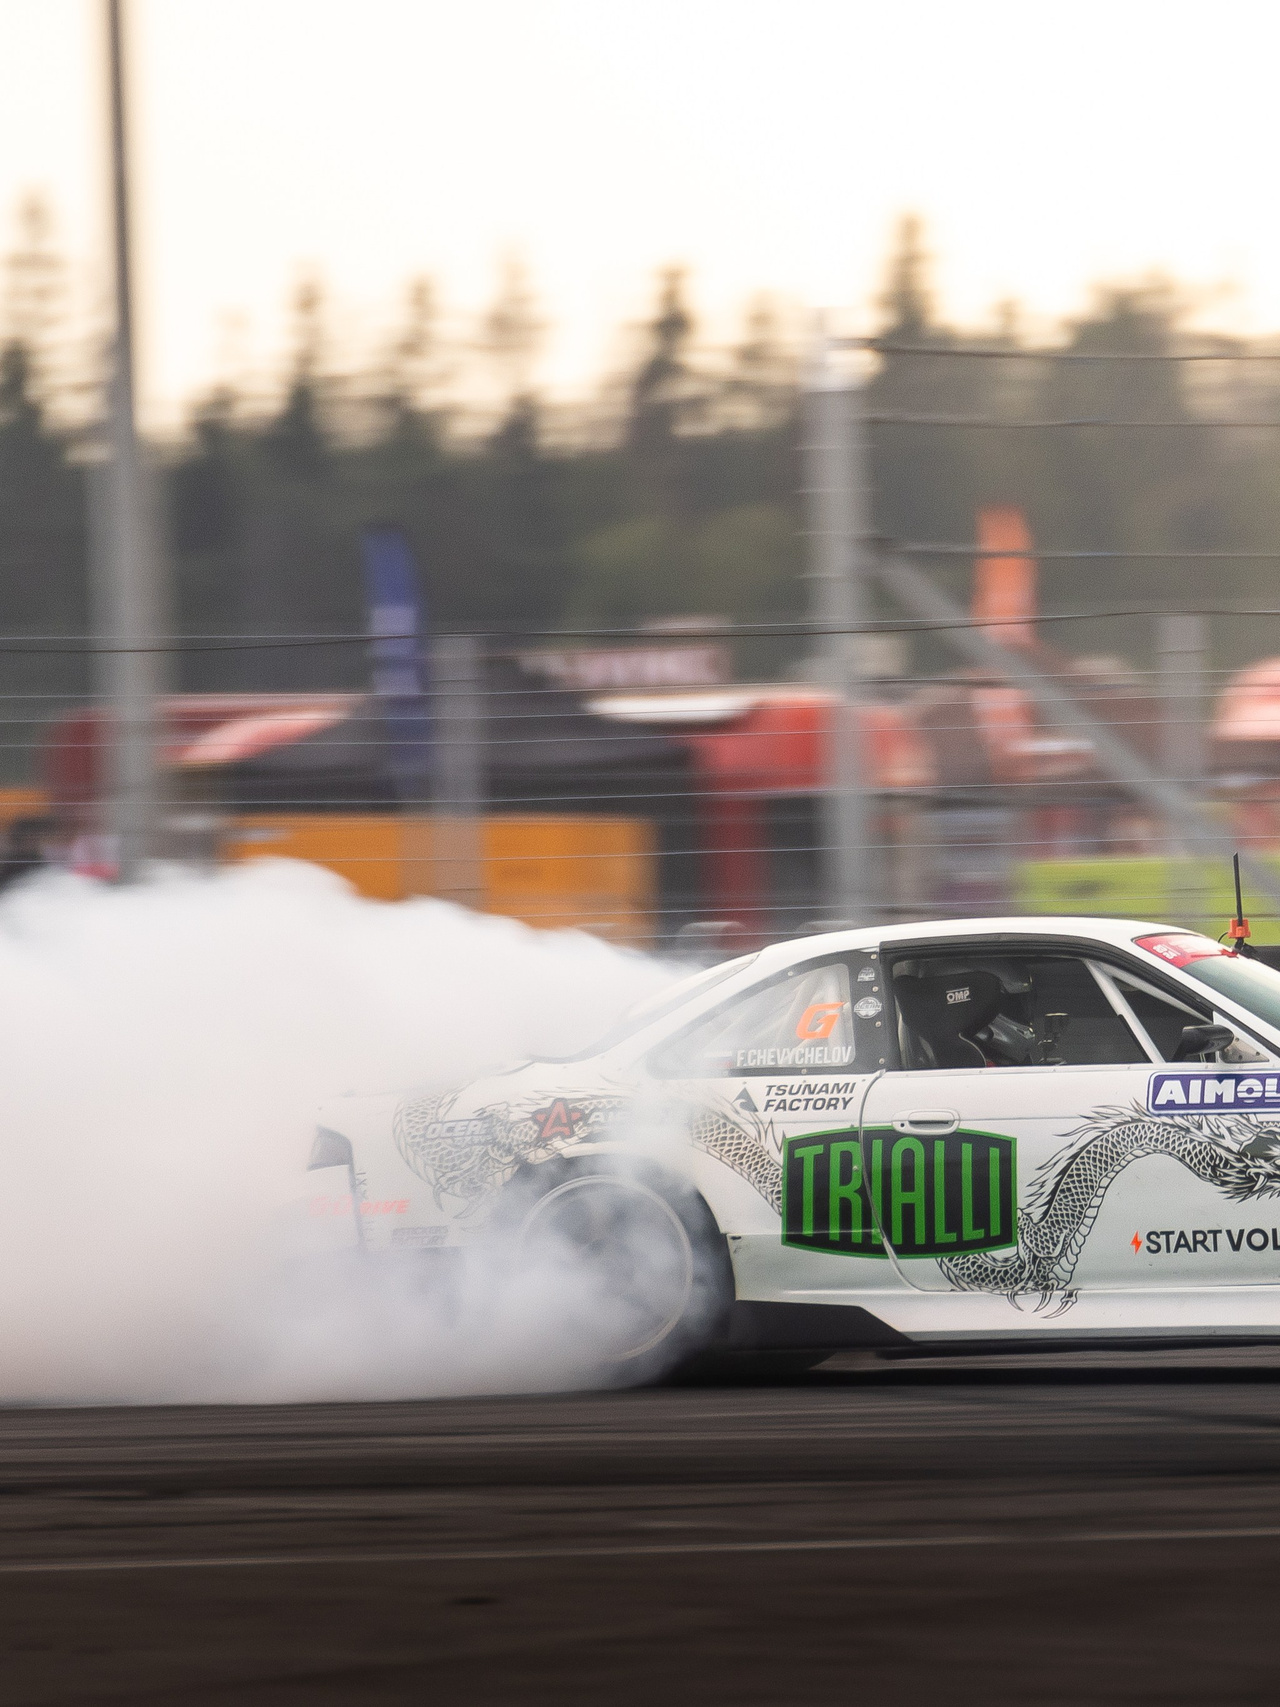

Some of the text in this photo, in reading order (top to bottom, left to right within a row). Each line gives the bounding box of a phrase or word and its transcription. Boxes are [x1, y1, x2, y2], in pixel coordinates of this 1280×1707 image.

[946, 990, 970, 1002] OMP
[736, 1046, 852, 1067] F.CHEVYCHELOV
[766, 1082, 856, 1096] TSUNAMI
[763, 1097, 854, 1112] FACTORY
[794, 1137, 1001, 1245] TRIALLI
